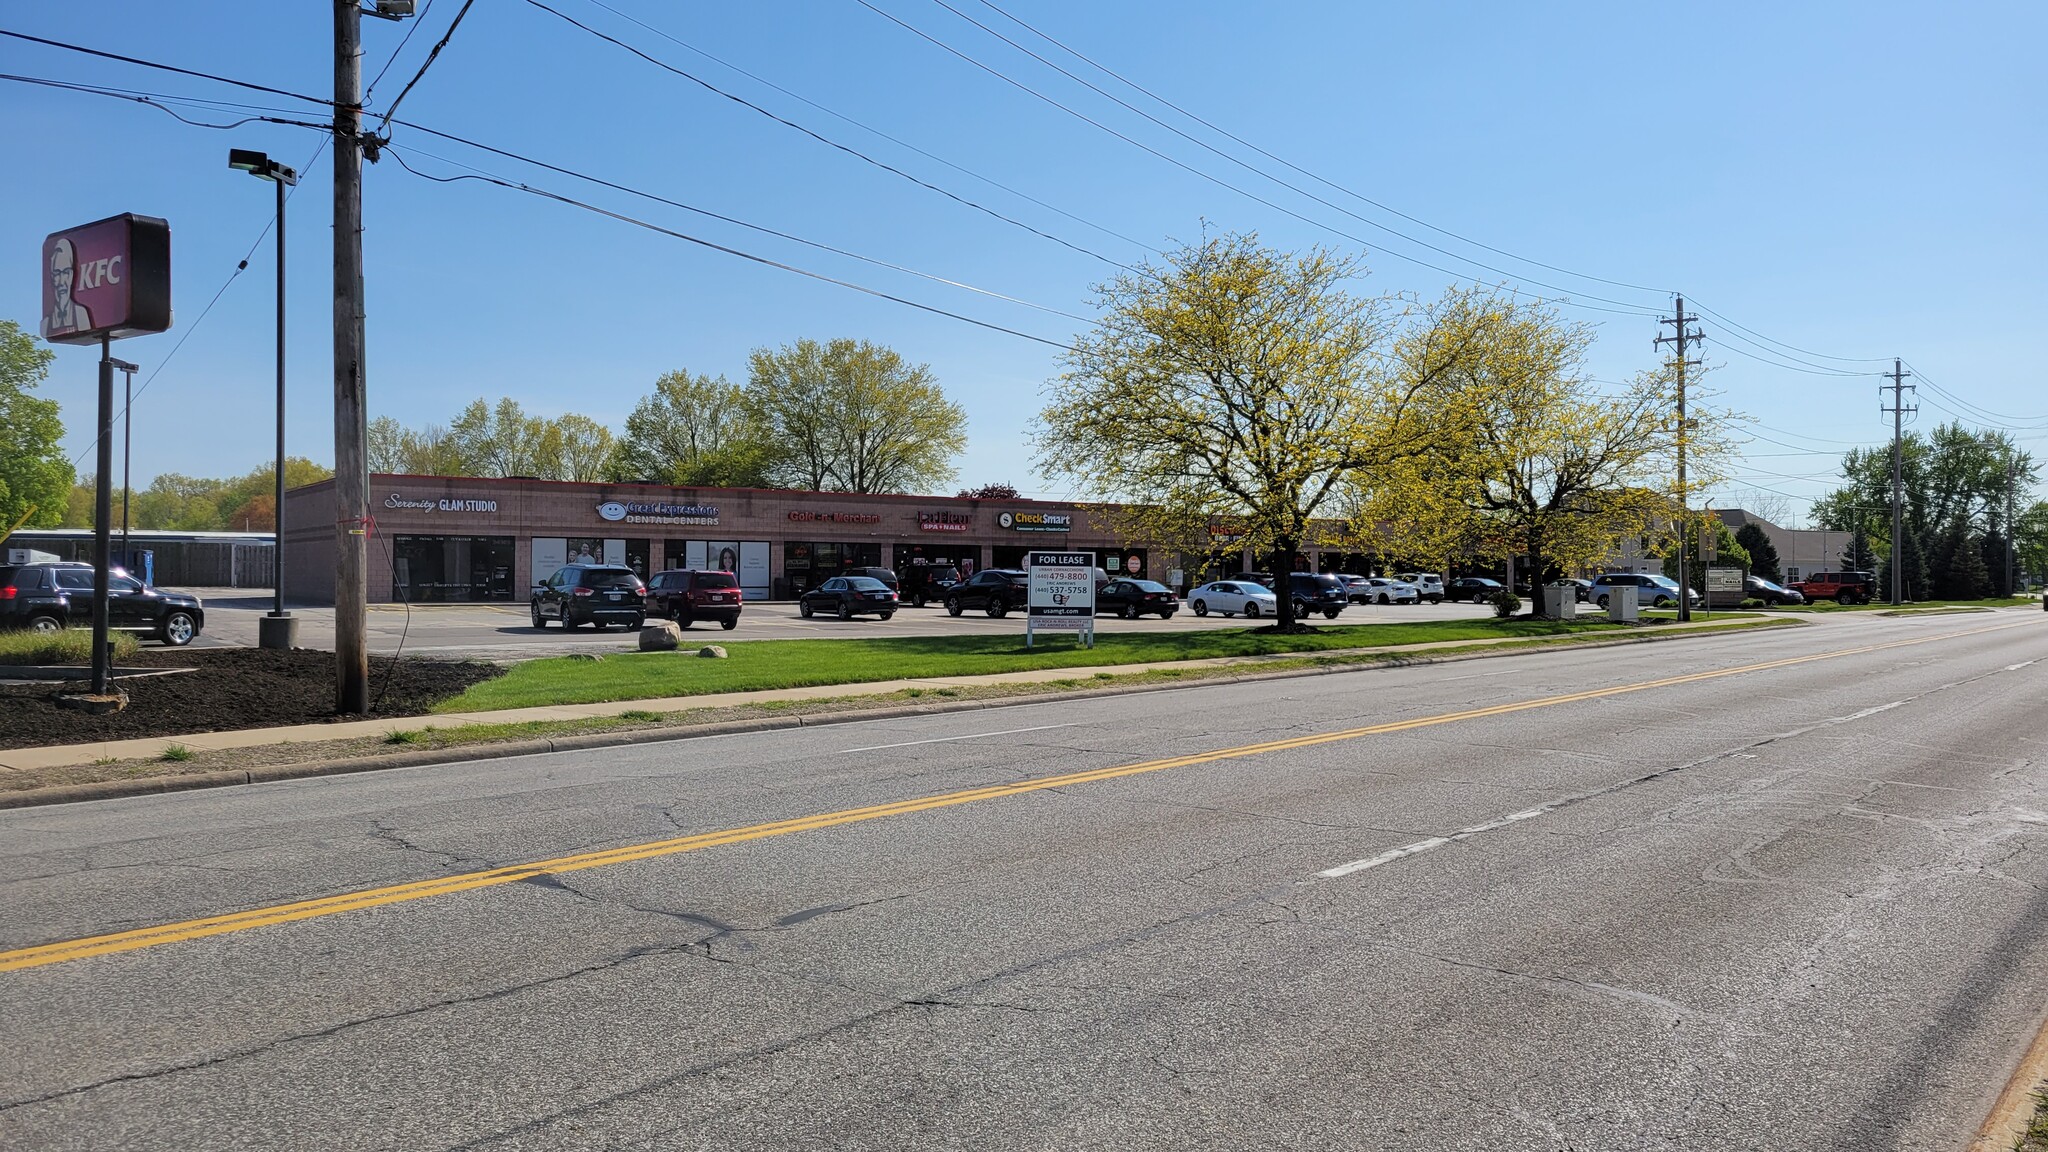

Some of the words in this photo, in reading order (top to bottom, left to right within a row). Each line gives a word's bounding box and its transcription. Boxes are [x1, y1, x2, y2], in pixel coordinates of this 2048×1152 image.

[78, 255, 122, 291] KFC
[385, 494, 436, 513] Serenity
[439, 500, 463, 511] GLAM
[466, 500, 497, 512] STUDIO
[627, 502, 656, 513] Great
[659, 502, 719, 516] Expressions
[627, 516, 669, 525] DENTAL
[673, 517, 719, 526] CENTERS
[789, 510, 816, 521] Gold
[1039, 555, 1056, 564] FOR
[1059, 555, 1084, 564] LEASE
[1049, 586, 1088, 594] 537-5758
